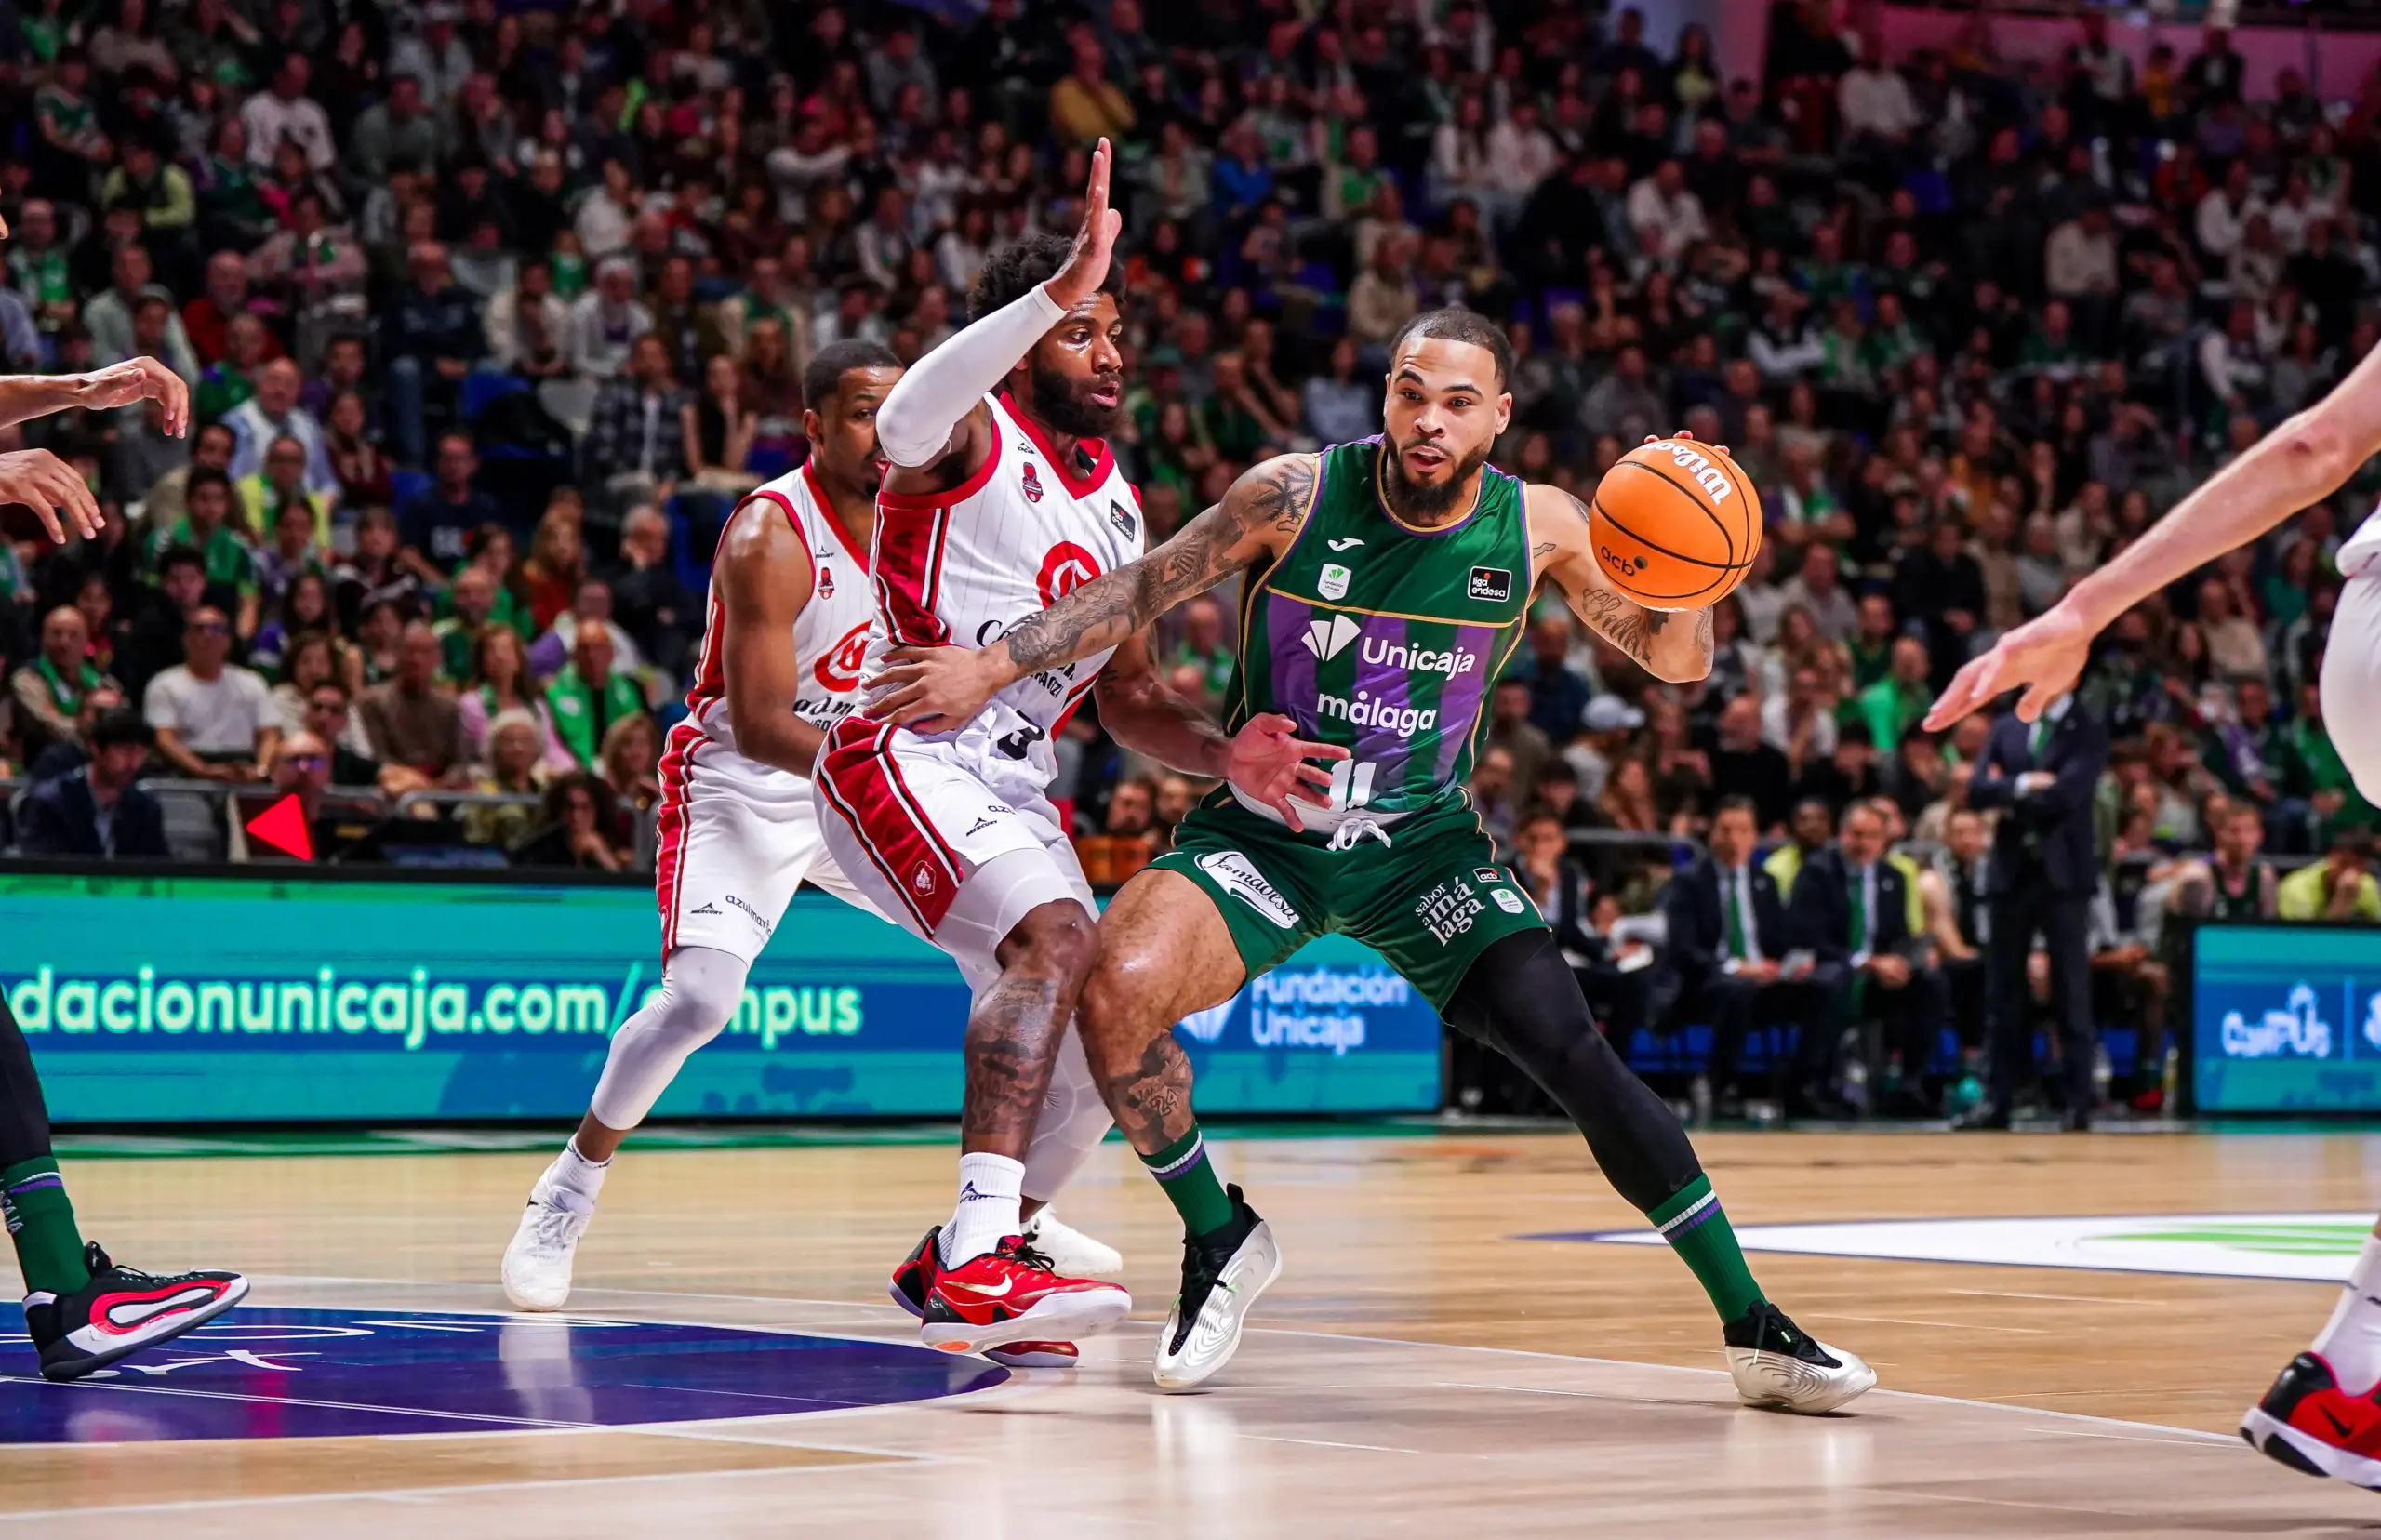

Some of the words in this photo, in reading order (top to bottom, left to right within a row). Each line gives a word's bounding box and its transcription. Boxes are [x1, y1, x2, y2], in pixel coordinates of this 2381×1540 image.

[1601, 546, 1635, 576] acb
[1471, 587, 1506, 597] endesa
[1472, 577, 1488, 587] liga
[1362, 636, 1476, 681] Unicaja
[1415, 883, 1446, 916] sabor
[1422, 916, 1431, 926] a
[1428, 898, 1486, 948] laga
[1251, 1004, 1366, 1056] Unicaja
